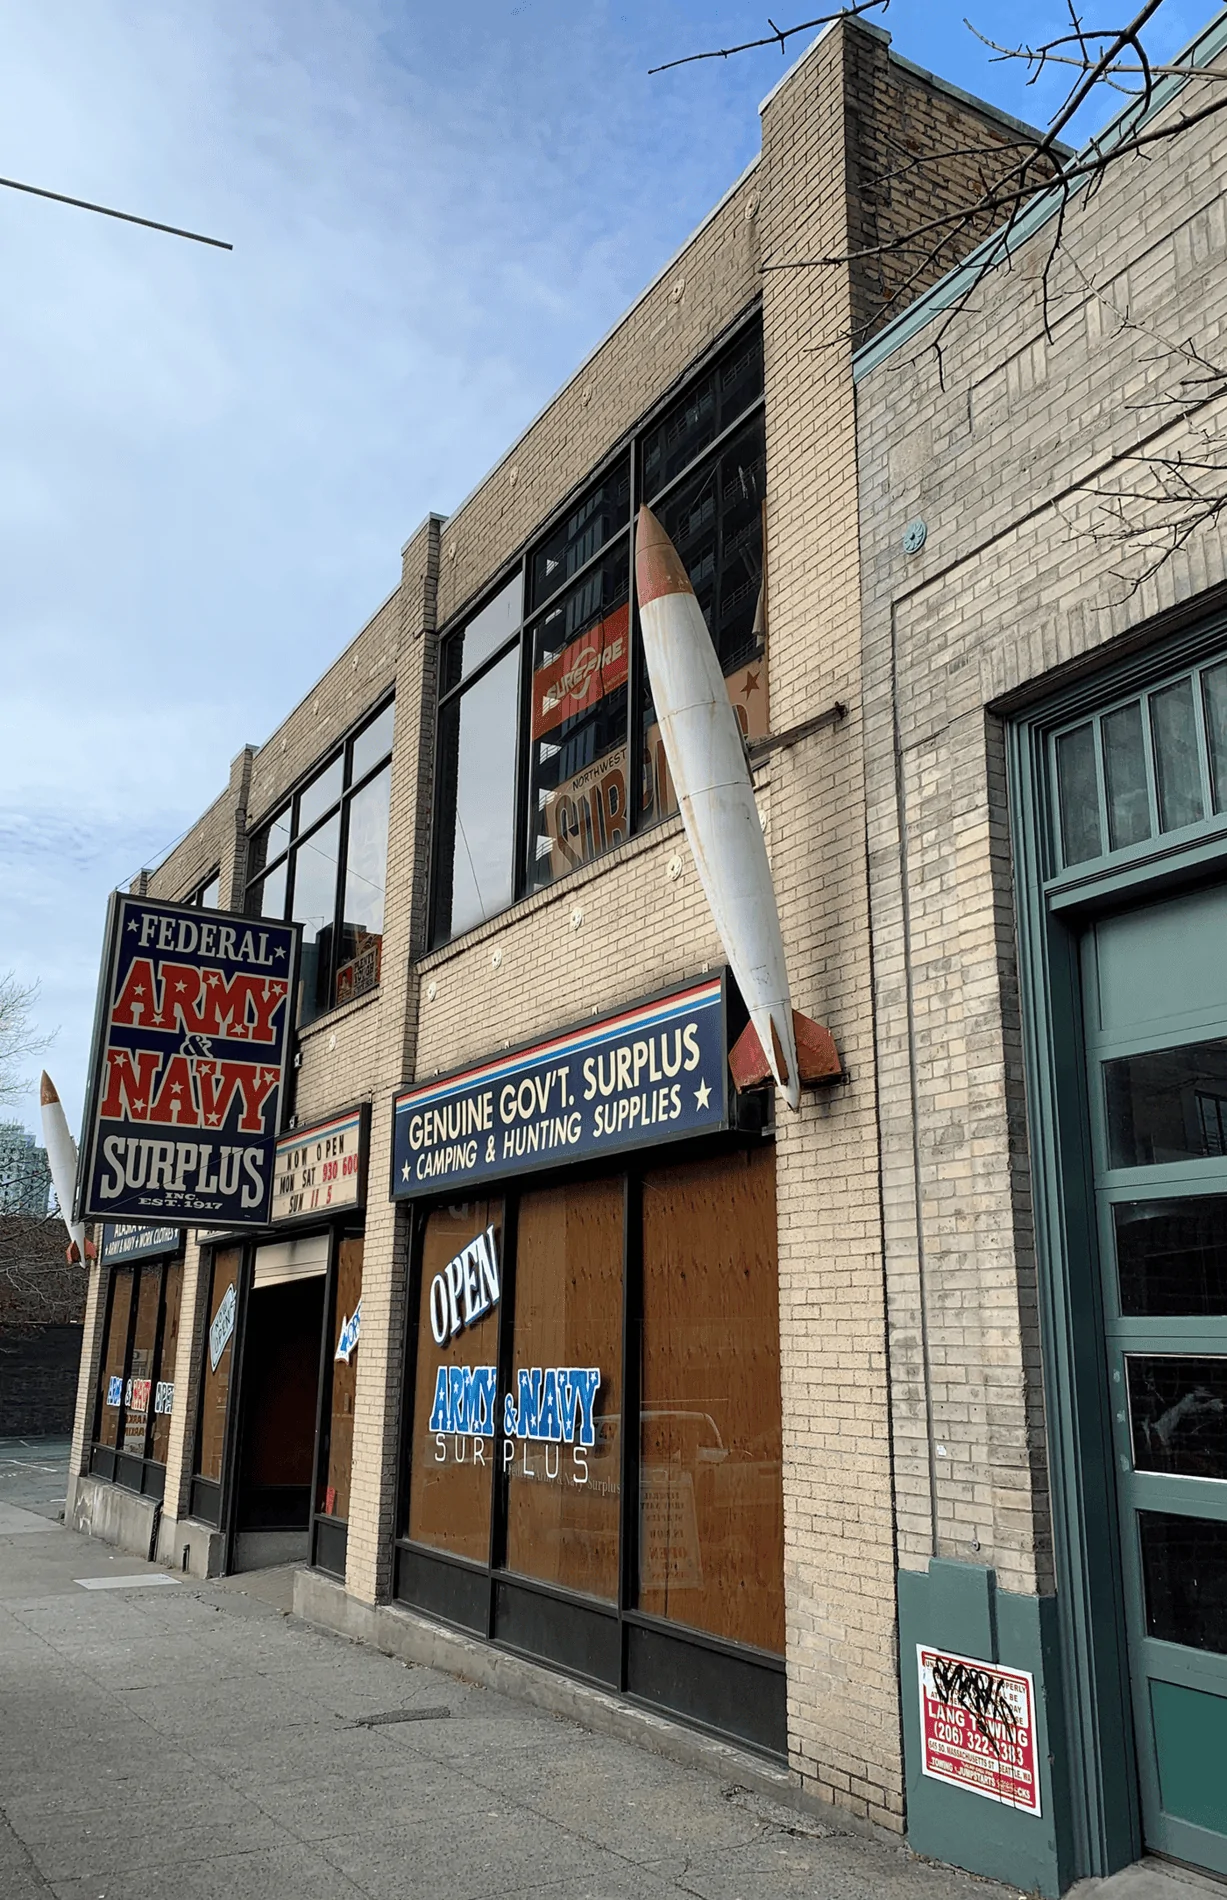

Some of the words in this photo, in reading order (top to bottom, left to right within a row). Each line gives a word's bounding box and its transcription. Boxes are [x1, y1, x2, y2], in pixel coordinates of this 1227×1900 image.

[546, 637, 624, 699] SUREFIRE
[572, 747, 627, 791] NORTHWEST
[138, 913, 273, 966] FEDERAL
[110, 956, 289, 1045] ARMY
[179, 1034, 213, 1059] &
[99, 1047, 281, 1134] NAVY
[409, 1091, 493, 1150] GENUINE
[500, 1066, 575, 1125] GOV'T.
[583, 1022, 700, 1101] SURPLUS
[287, 1147, 308, 1171] NOW
[317, 1134, 345, 1161] OPEN
[416, 1140, 478, 1180] CAMPING
[485, 1134, 496, 1163] &
[503, 1112, 582, 1159] HUNTING
[593, 1083, 682, 1138] SUPPLIES
[99, 1134, 264, 1209] SURPLUS
[280, 1173, 295, 1195] MON
[302, 1167, 316, 1188] SAT
[322, 1161, 338, 1182] 930
[342, 1153, 358, 1176] 600
[138, 1197, 181, 1207] EST.
[184, 1200, 223, 1210] 1917
[165, 1192, 199, 1200] INC.
[288, 1193, 304, 1214] SUN
[430, 1222, 501, 1346] OPEN
[155, 1381, 175, 1415] OPE
[429, 1365, 497, 1437] ARMY
[503, 1393, 517, 1437] &
[516, 1367, 600, 1446] NAVY
[434, 1432, 589, 1484] SURPLUS
[587, 1476, 621, 1497] Surplus
[1009, 1693, 1018, 1702] BE
[928, 1702, 965, 1727] LANG
[969, 1713, 1028, 1747] TWING
[934, 1721, 963, 1747] (206)
[988, 1760, 995, 1769] ST
